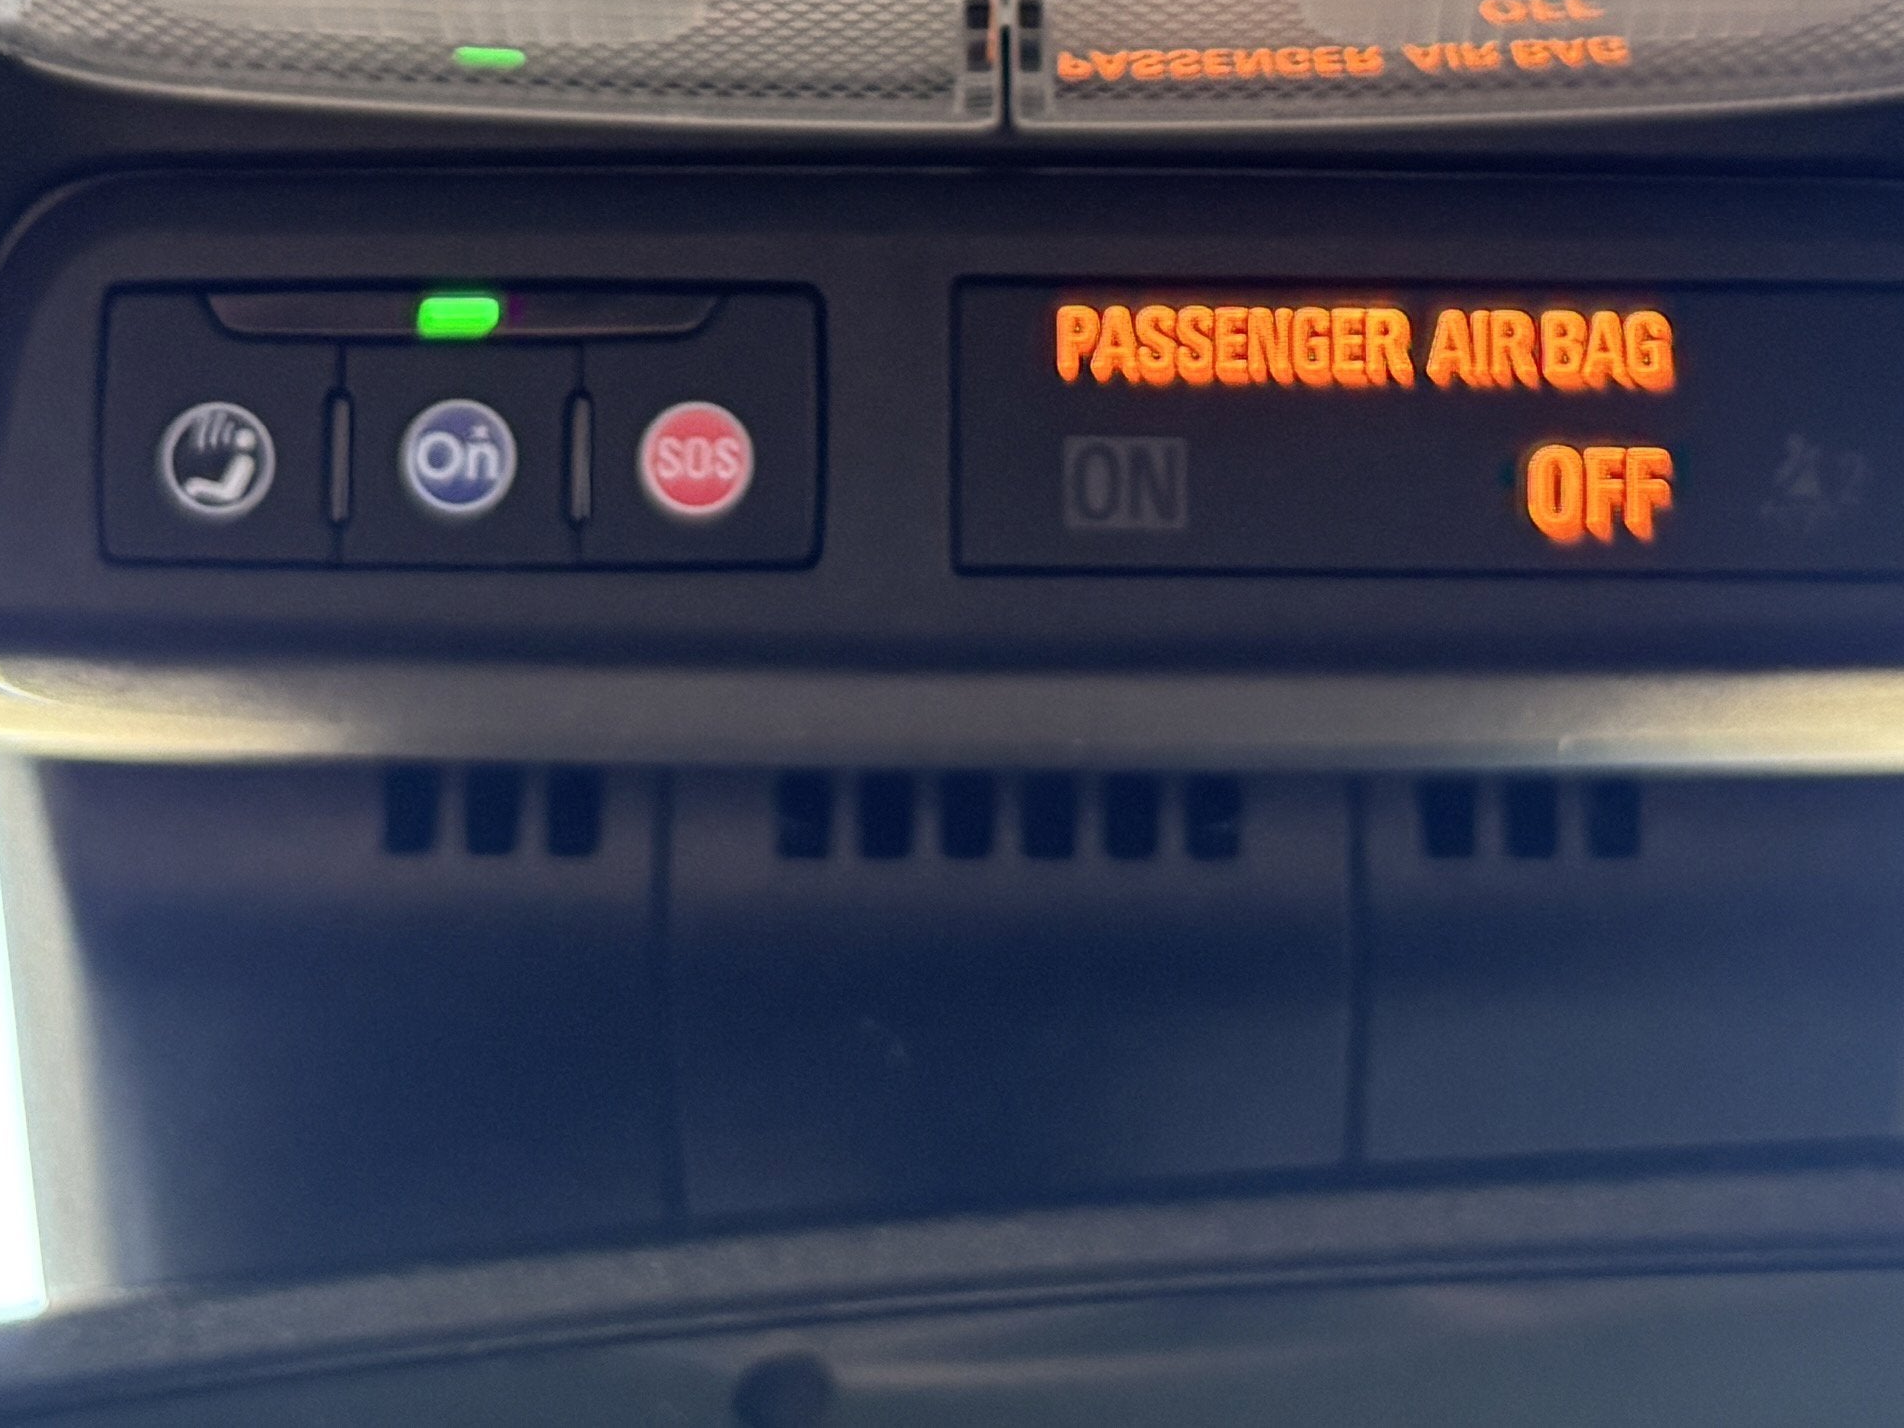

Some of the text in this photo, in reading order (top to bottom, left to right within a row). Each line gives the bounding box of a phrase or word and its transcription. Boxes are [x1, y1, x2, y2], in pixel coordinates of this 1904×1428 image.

[1056, 304, 1674, 392] PASSENGER AIR BAG
[654, 436, 741, 483] SOS
[1076, 442, 1180, 527] ON
[1526, 444, 1673, 542] OFF
